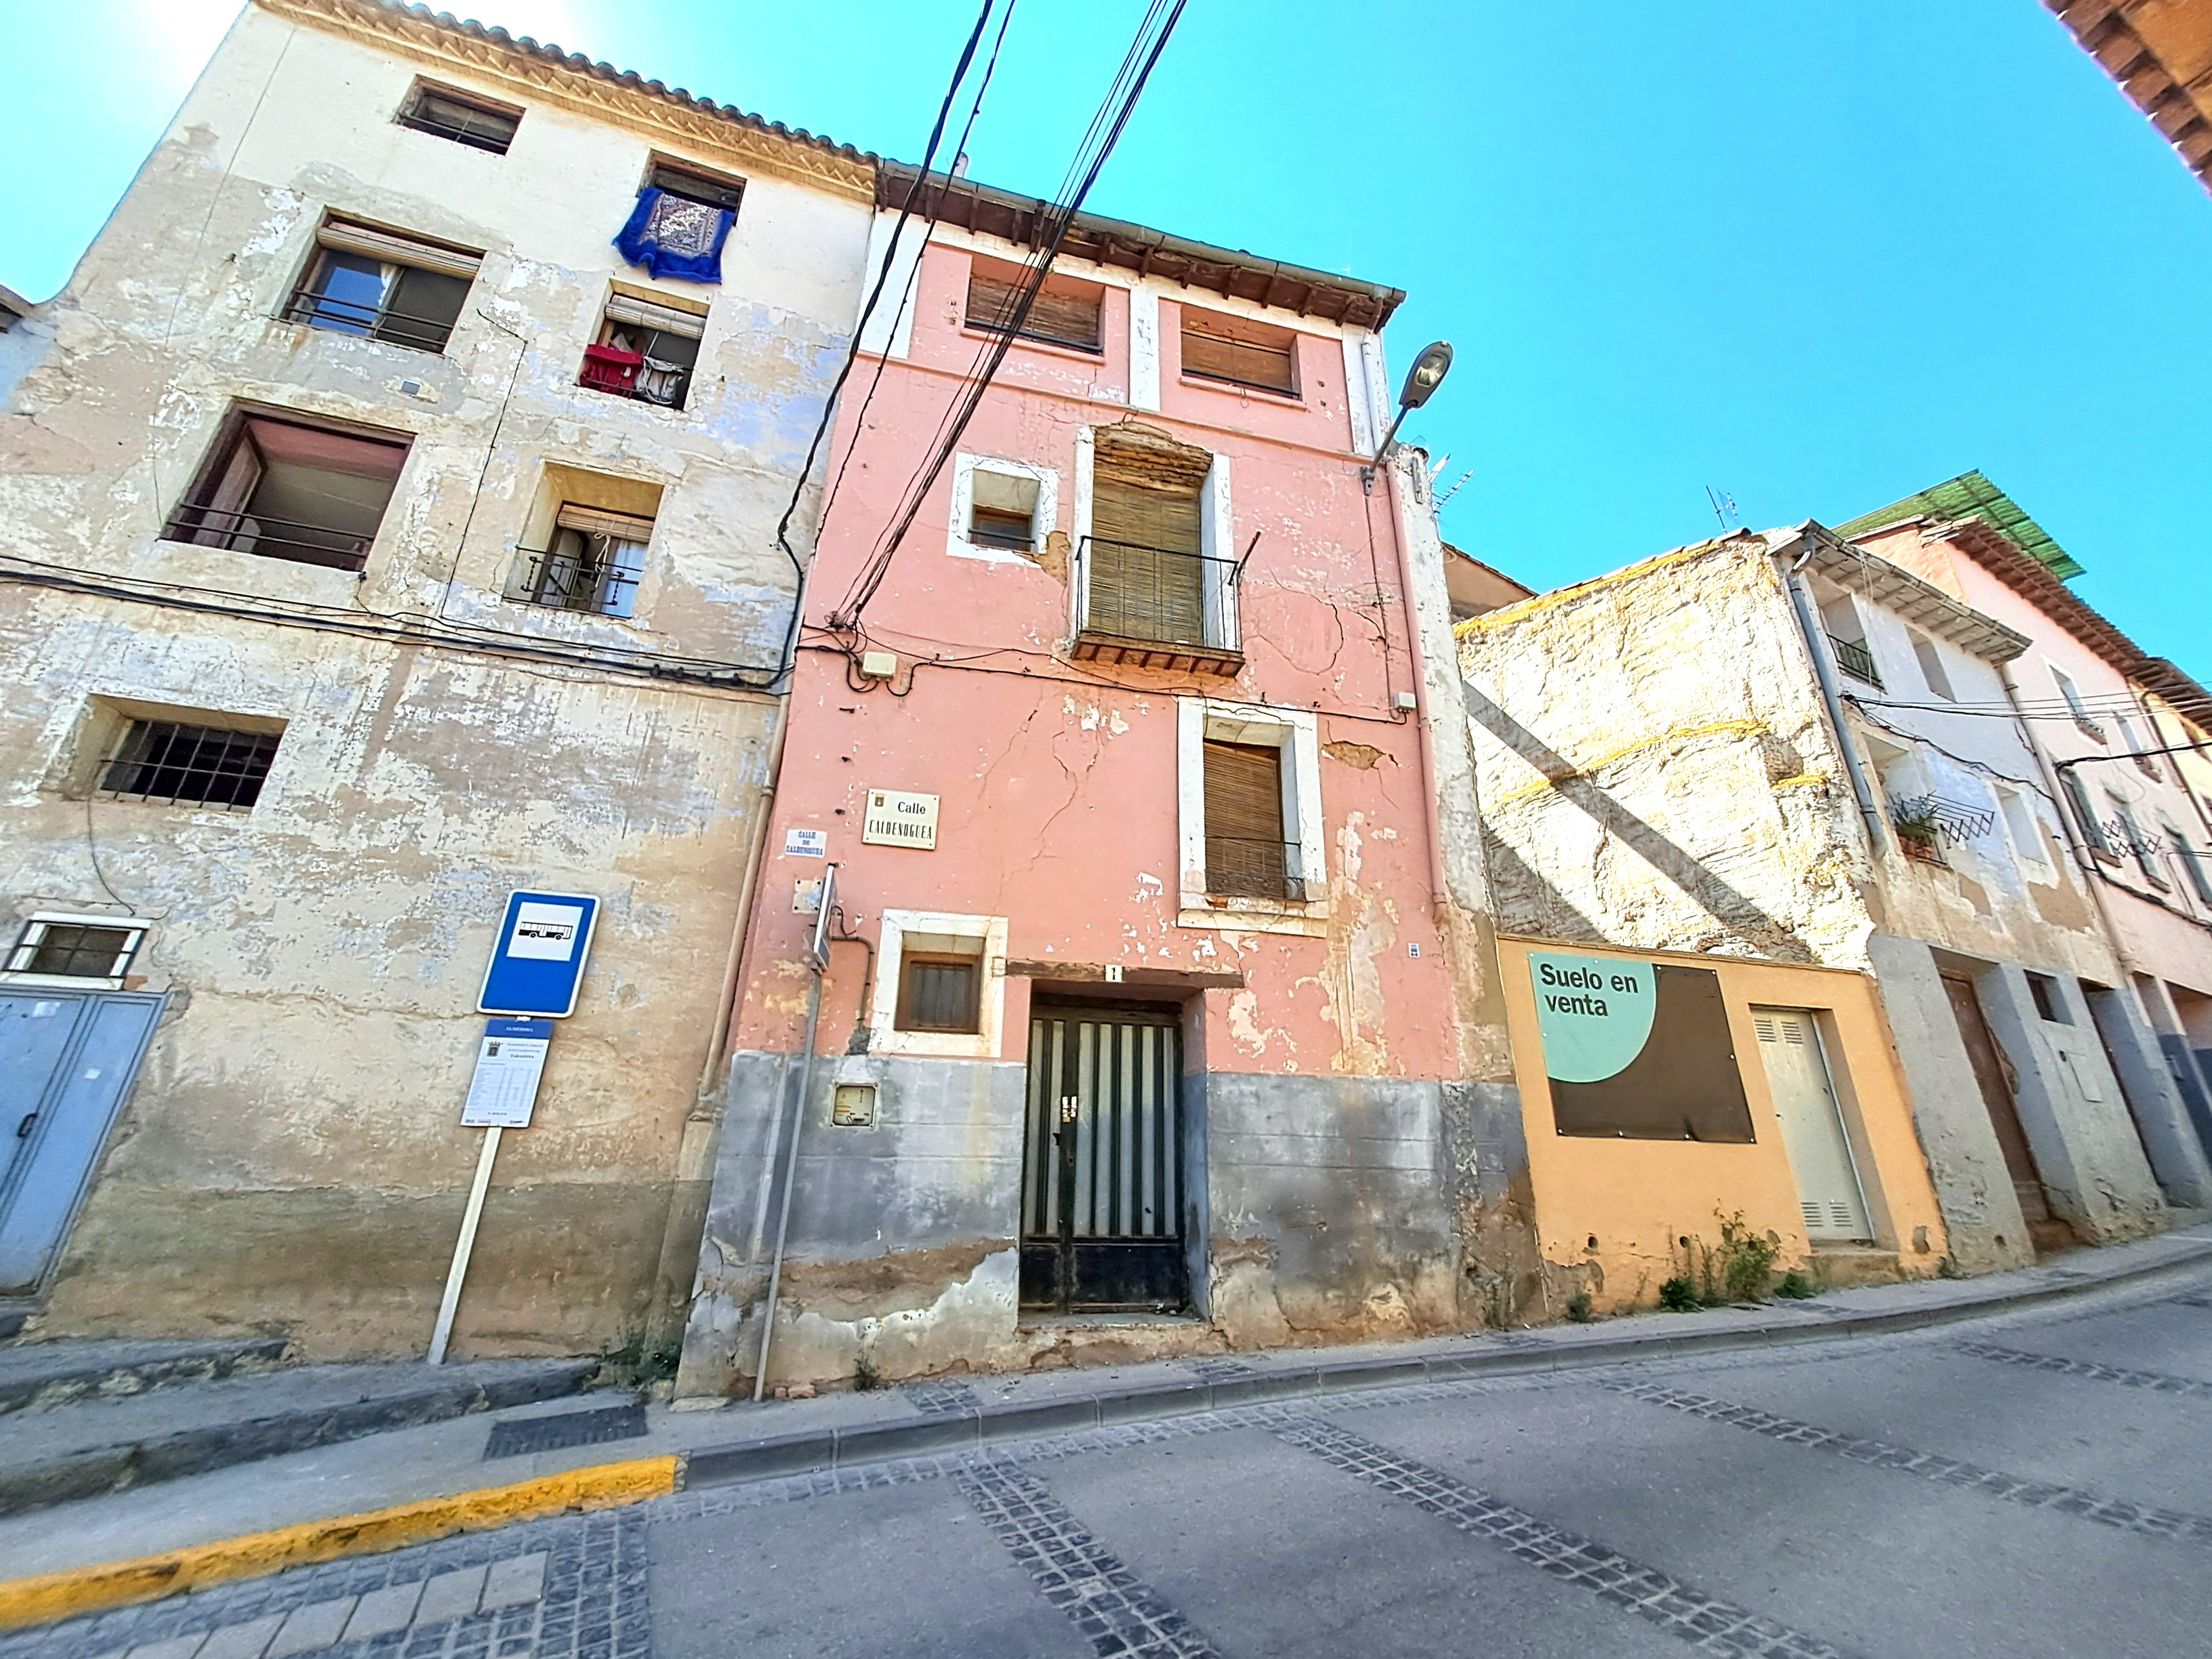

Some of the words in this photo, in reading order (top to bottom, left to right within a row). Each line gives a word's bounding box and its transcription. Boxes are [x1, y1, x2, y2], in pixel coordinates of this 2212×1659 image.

[897, 801, 926, 815] Calle
[869, 819, 932, 840] CALDENOGUEA
[1111, 967, 1115, 980] 1
[1540, 963, 1603, 990] Suelo
[1610, 974, 1639, 994] en
[1544, 994, 1609, 1017] venta
